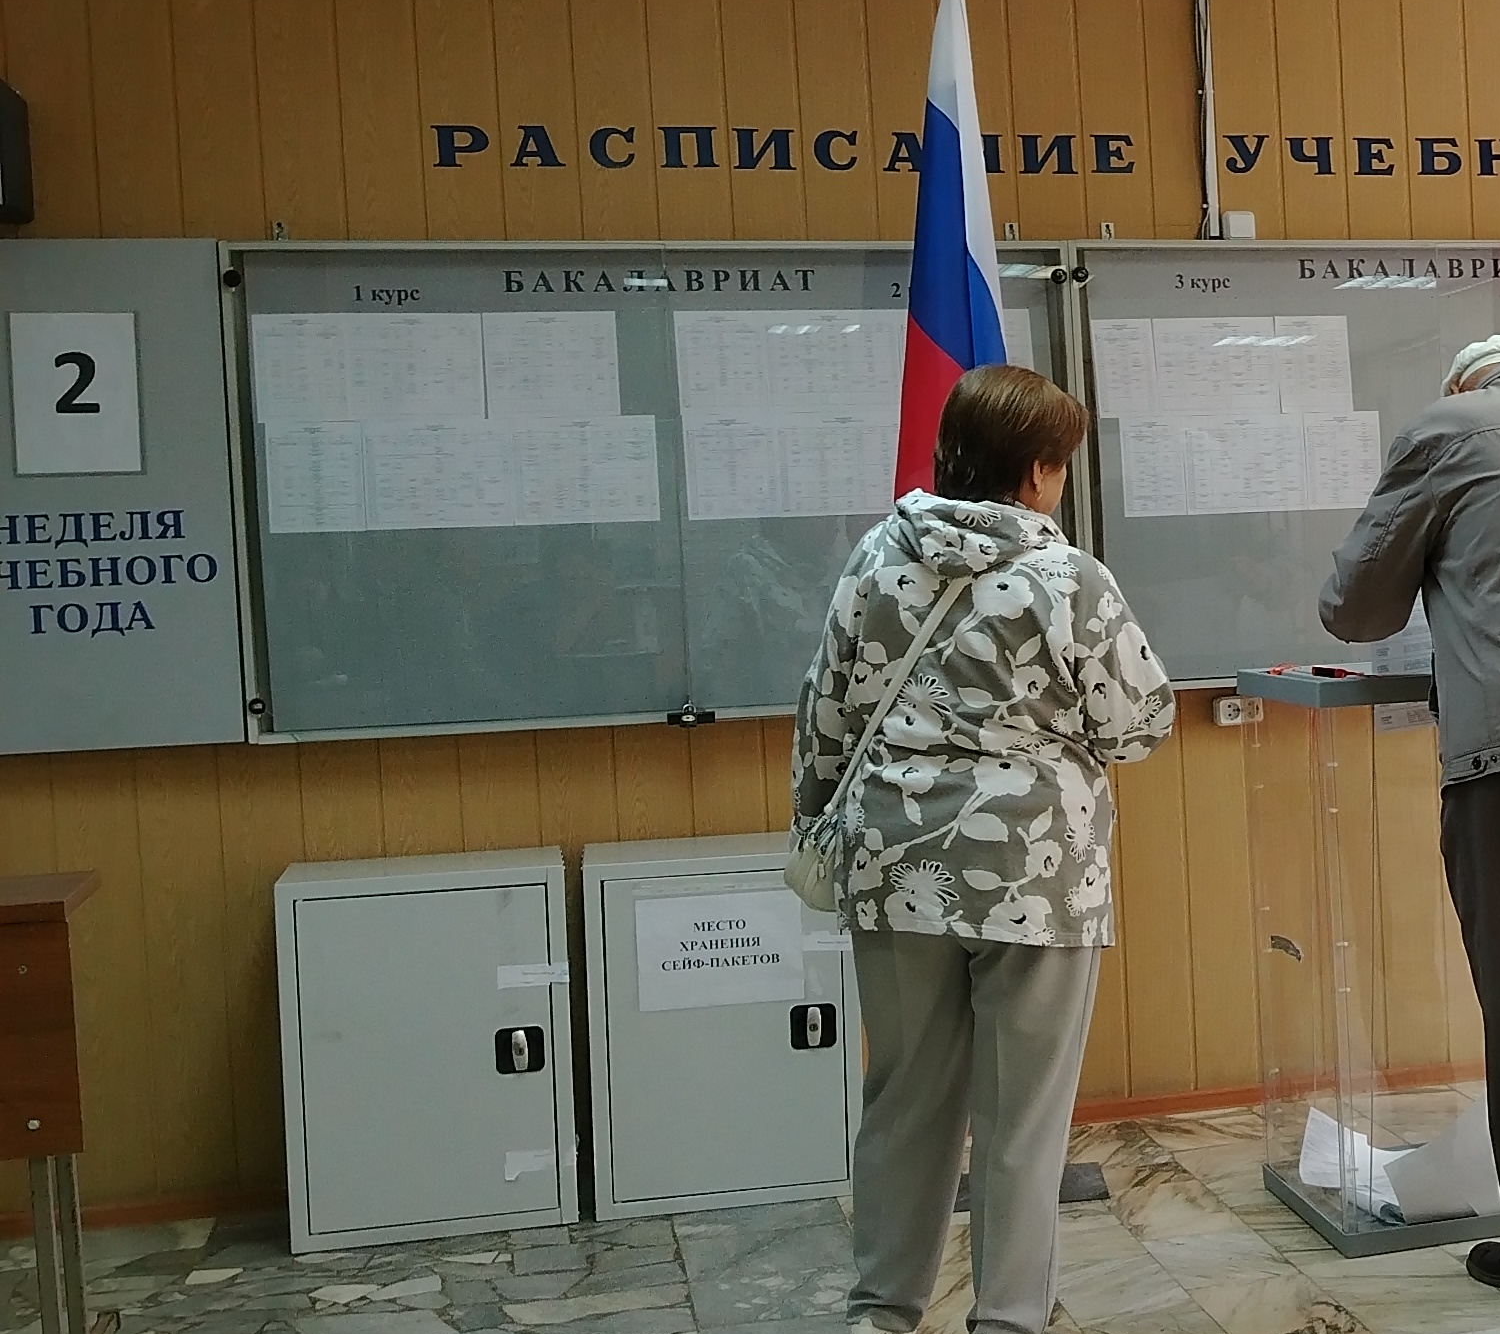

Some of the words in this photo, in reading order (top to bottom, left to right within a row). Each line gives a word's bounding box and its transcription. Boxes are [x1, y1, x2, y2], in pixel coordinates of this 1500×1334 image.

[503, 269, 815, 294] БАКАЛАВРИАТ
[890, 282, 902, 298] 2
[1175, 274, 1184, 289] 3
[1190, 277, 1231, 293] курс
[353, 285, 363, 301] 1
[371, 288, 420, 305] курс
[54, 352, 100, 413] 2
[30, 600, 156, 638] ГОДА
[693, 919, 746, 932] МЕСТО
[679, 936, 761, 952] ХРАНЕНИЯ
[661, 953, 780, 971] СЕЙФ-ПАКЕТОВ
